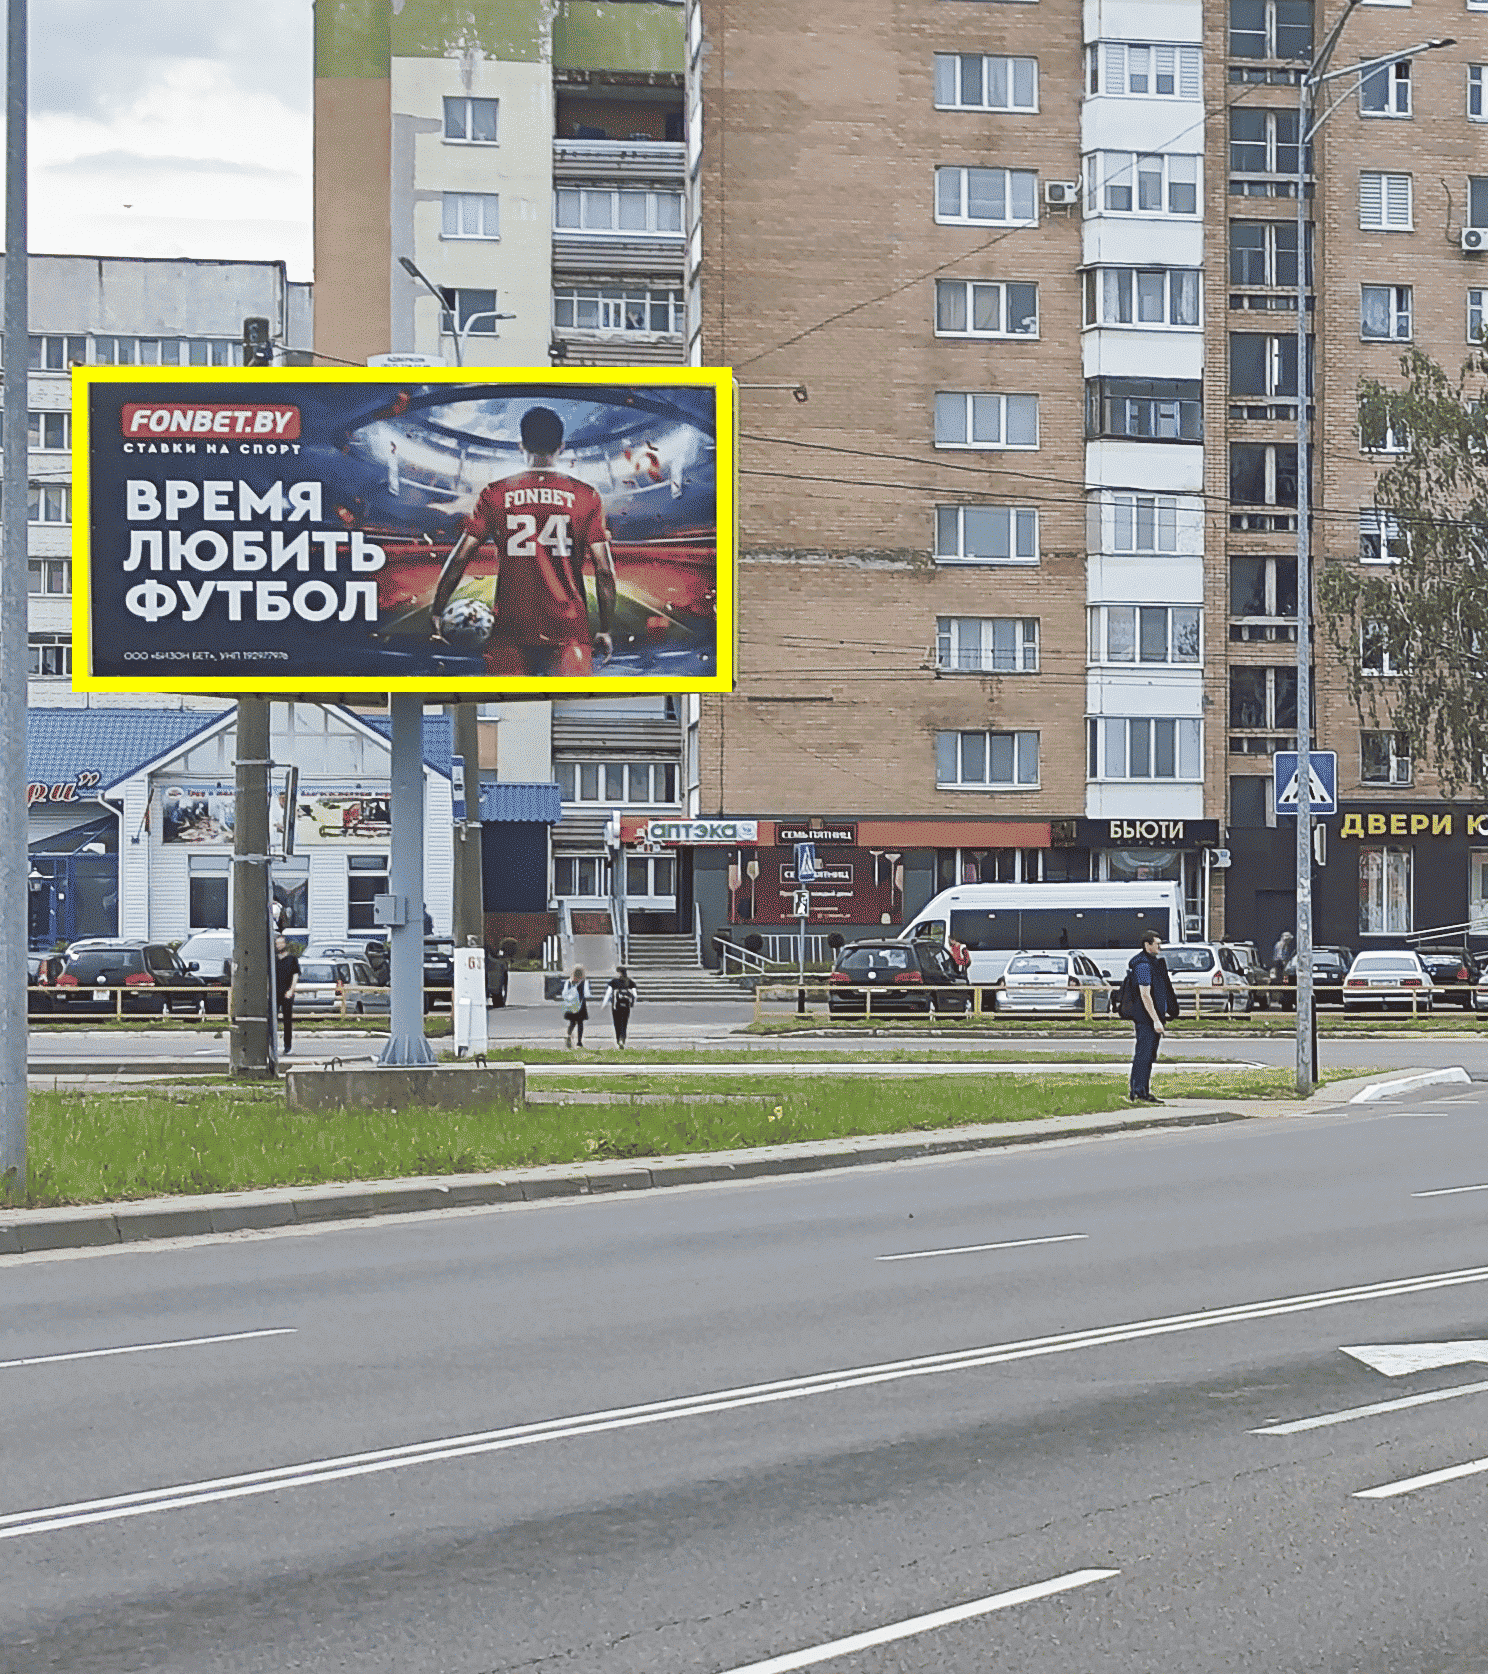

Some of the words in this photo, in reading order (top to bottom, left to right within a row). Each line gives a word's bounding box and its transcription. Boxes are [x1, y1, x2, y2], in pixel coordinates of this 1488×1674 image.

[130, 409, 293, 433] FONBET.BY
[123, 443, 197, 455] СТАВКИ
[206, 443, 232, 455] НА
[240, 443, 302, 455] СПОРТ
[125, 480, 323, 522] ВРЕМЯ
[504, 489, 577, 508] FONBET
[506, 513, 575, 558] 24
[123, 530, 386, 573] ЛЮБИТЬ
[124, 580, 379, 623] ФУТБОЛ
[123, 651, 149, 661] ООО
[1109, 820, 1184, 839] БЬЮТИ
[1340, 813, 1453, 839] ДВЕРИ
